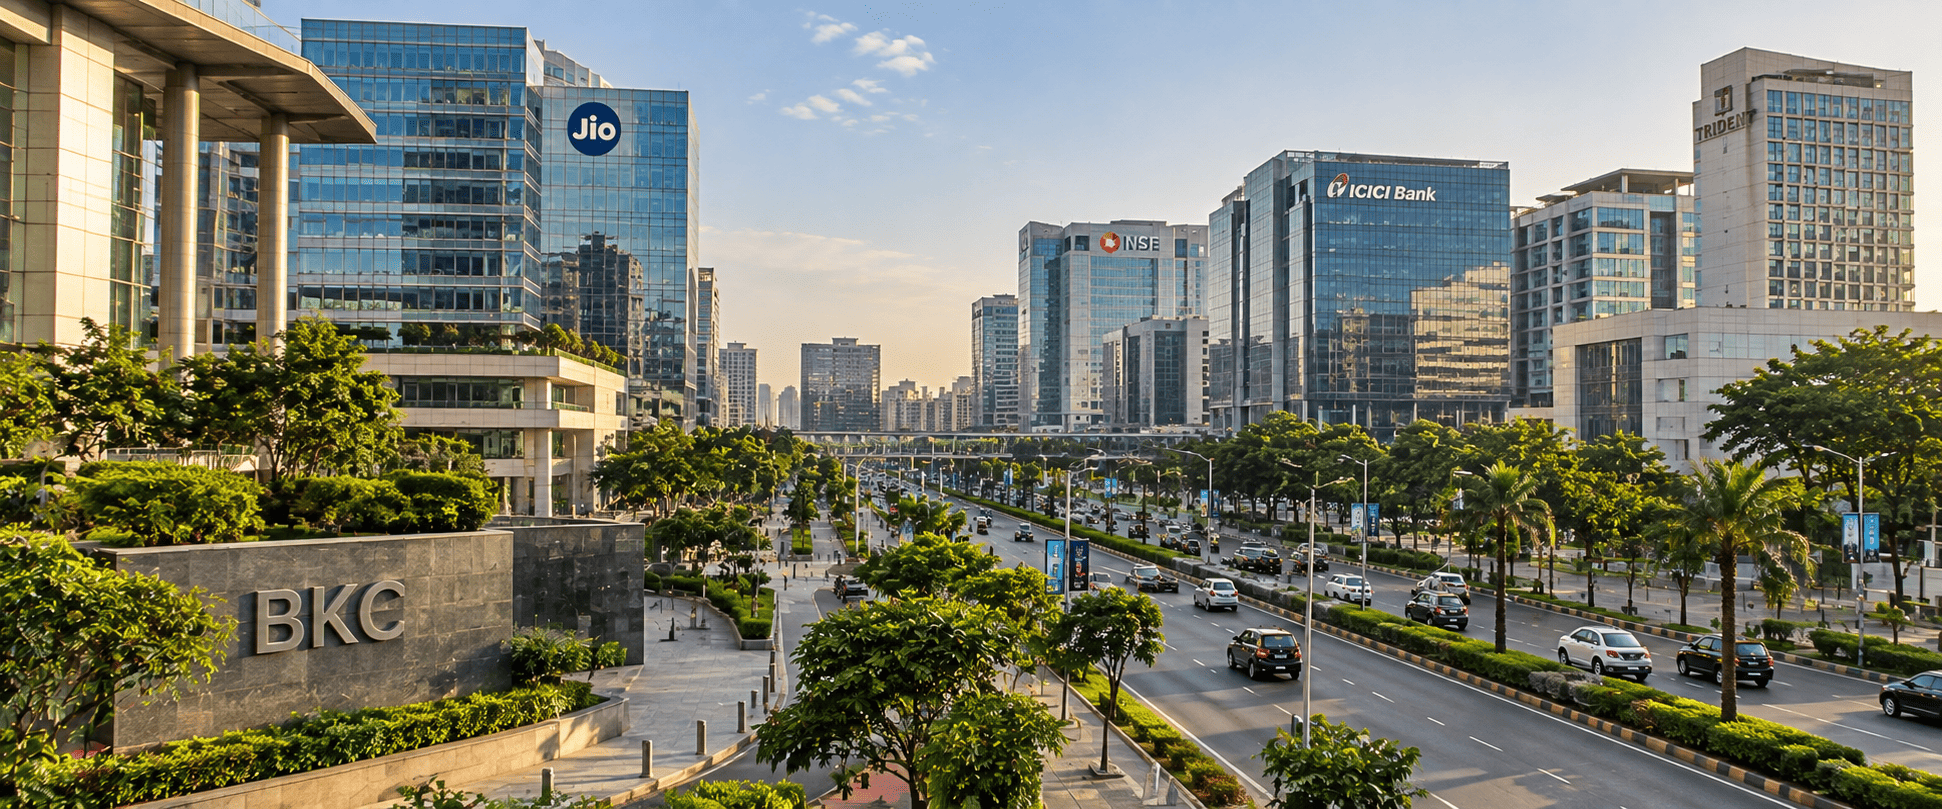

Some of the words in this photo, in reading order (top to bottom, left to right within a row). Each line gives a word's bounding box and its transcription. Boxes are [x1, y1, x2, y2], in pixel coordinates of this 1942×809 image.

[572, 114, 616, 140] Jio
[1695, 109, 1757, 141] TRIDENT
[1349, 184, 1391, 199] ICICI
[1394, 186, 1436, 201] Bank
[1124, 235, 1159, 251] NSE
[257, 580, 405, 654] BKC
